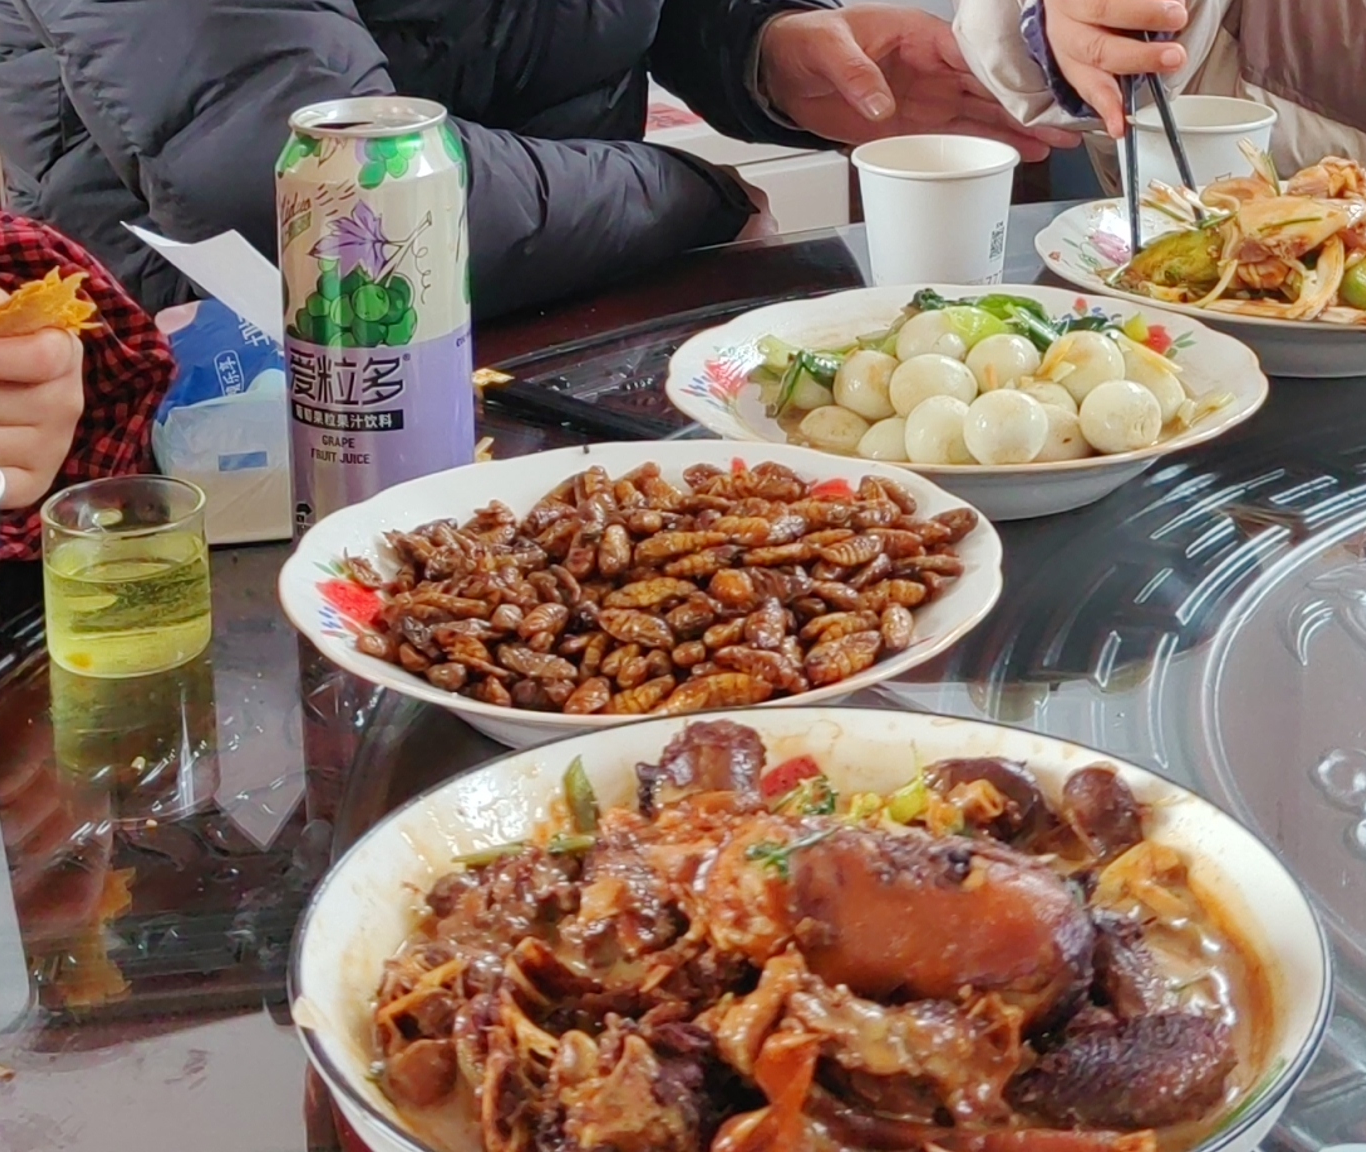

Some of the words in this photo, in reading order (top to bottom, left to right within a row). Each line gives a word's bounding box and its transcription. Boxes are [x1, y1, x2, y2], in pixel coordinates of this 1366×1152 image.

[290, 347, 404, 406] 爱粒多
[321, 435, 355, 449] GRAPE
[310, 448, 336, 463] FRUIT
[339, 452, 371, 465] JUICE
